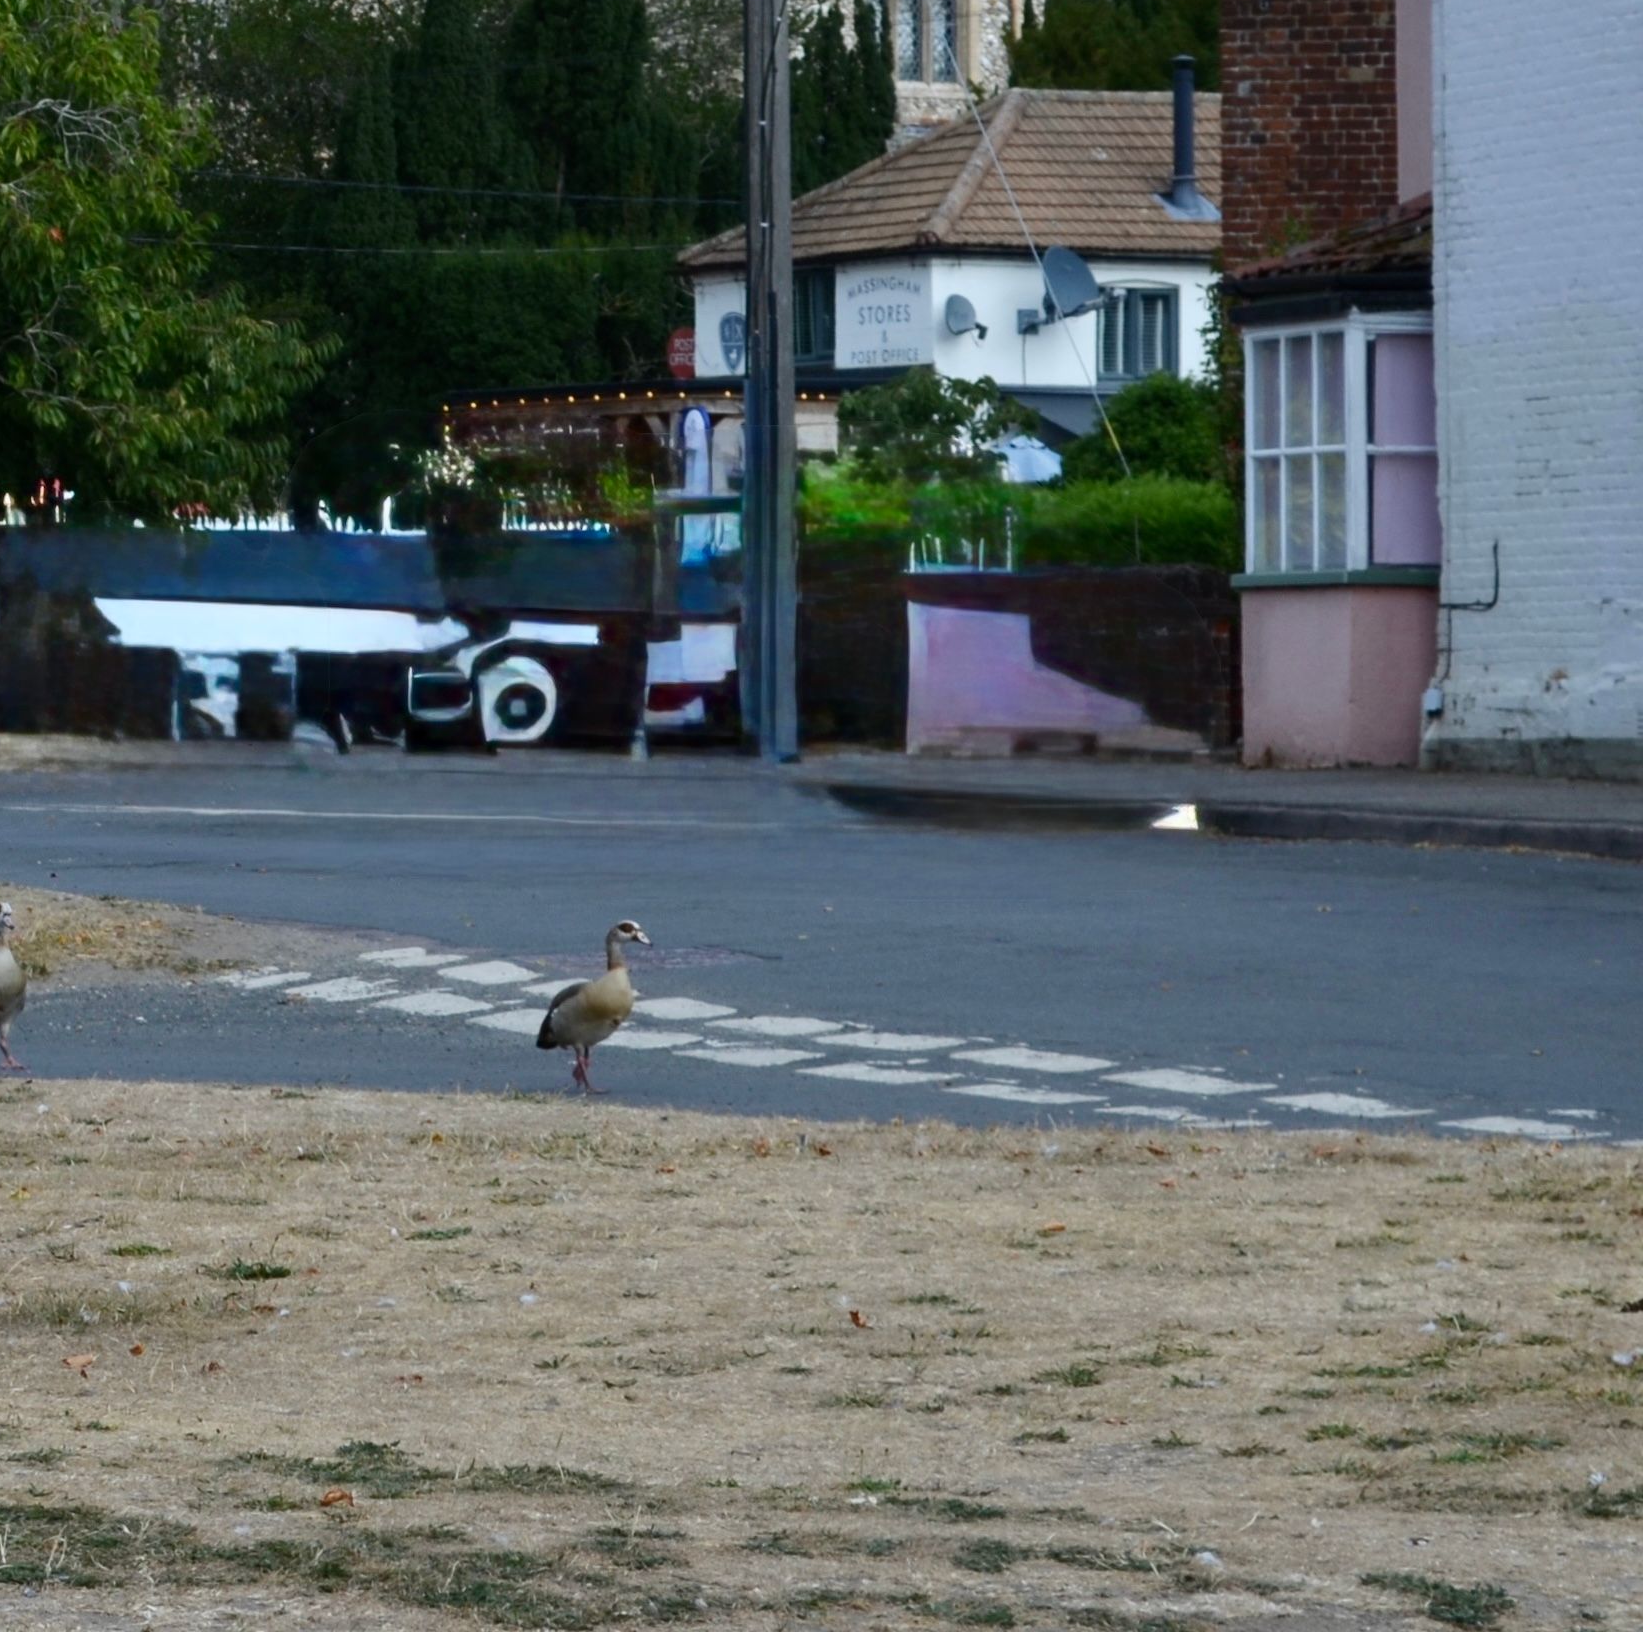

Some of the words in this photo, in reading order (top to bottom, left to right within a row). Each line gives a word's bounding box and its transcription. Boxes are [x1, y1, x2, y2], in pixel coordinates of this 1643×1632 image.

[847, 276, 921, 299] MASSINGHAM
[858, 304, 911, 325] STORES
[674, 338, 694, 351] POST
[669, 353, 695, 366] OFFIC
[850, 350, 877, 364] POST
[881, 348, 919, 363] OFFICE
